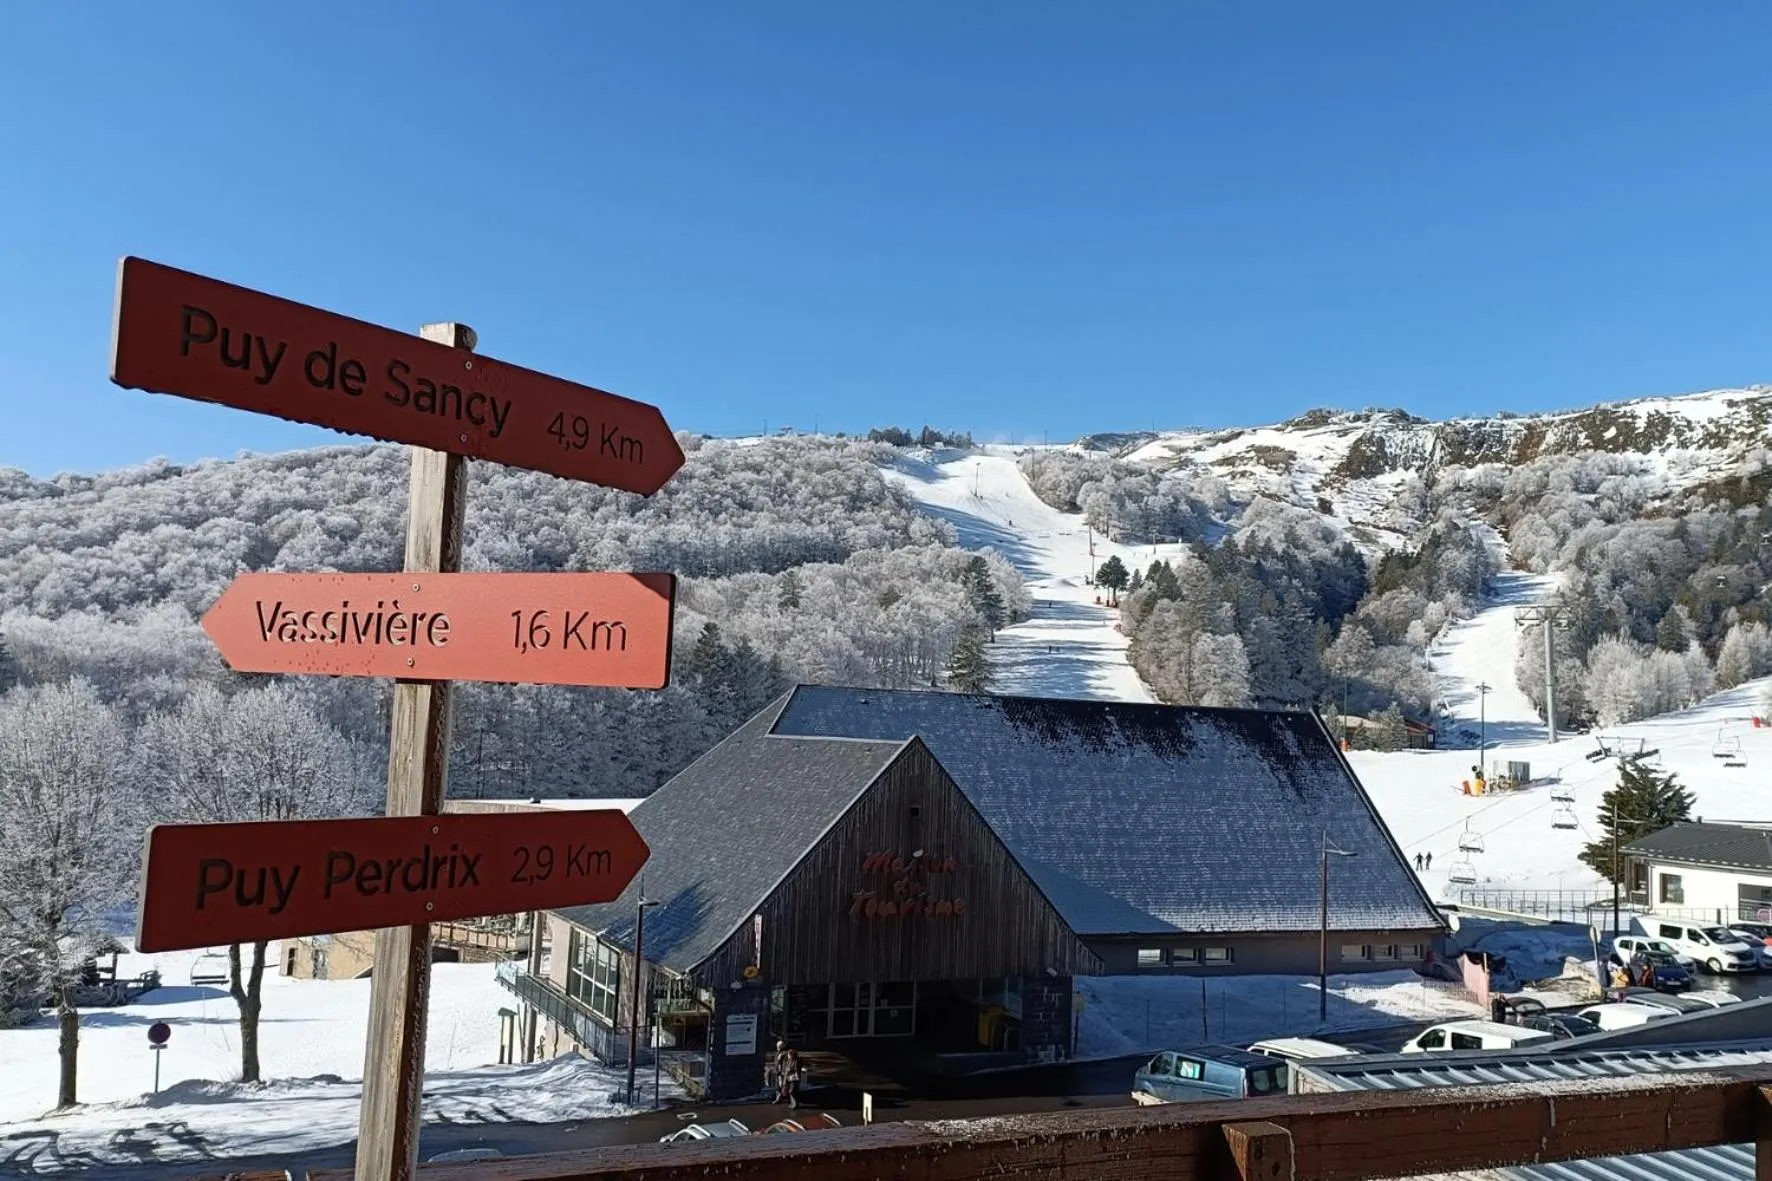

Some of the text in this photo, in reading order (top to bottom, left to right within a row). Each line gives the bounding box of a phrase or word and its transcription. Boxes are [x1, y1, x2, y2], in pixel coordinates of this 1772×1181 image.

[180, 304, 644, 465] Puy de Sancy 4,9 Km
[256, 600, 627, 654] Vassivière 1,6 Km
[196, 844, 612, 914] Puy Perdrix 2,9 Km
